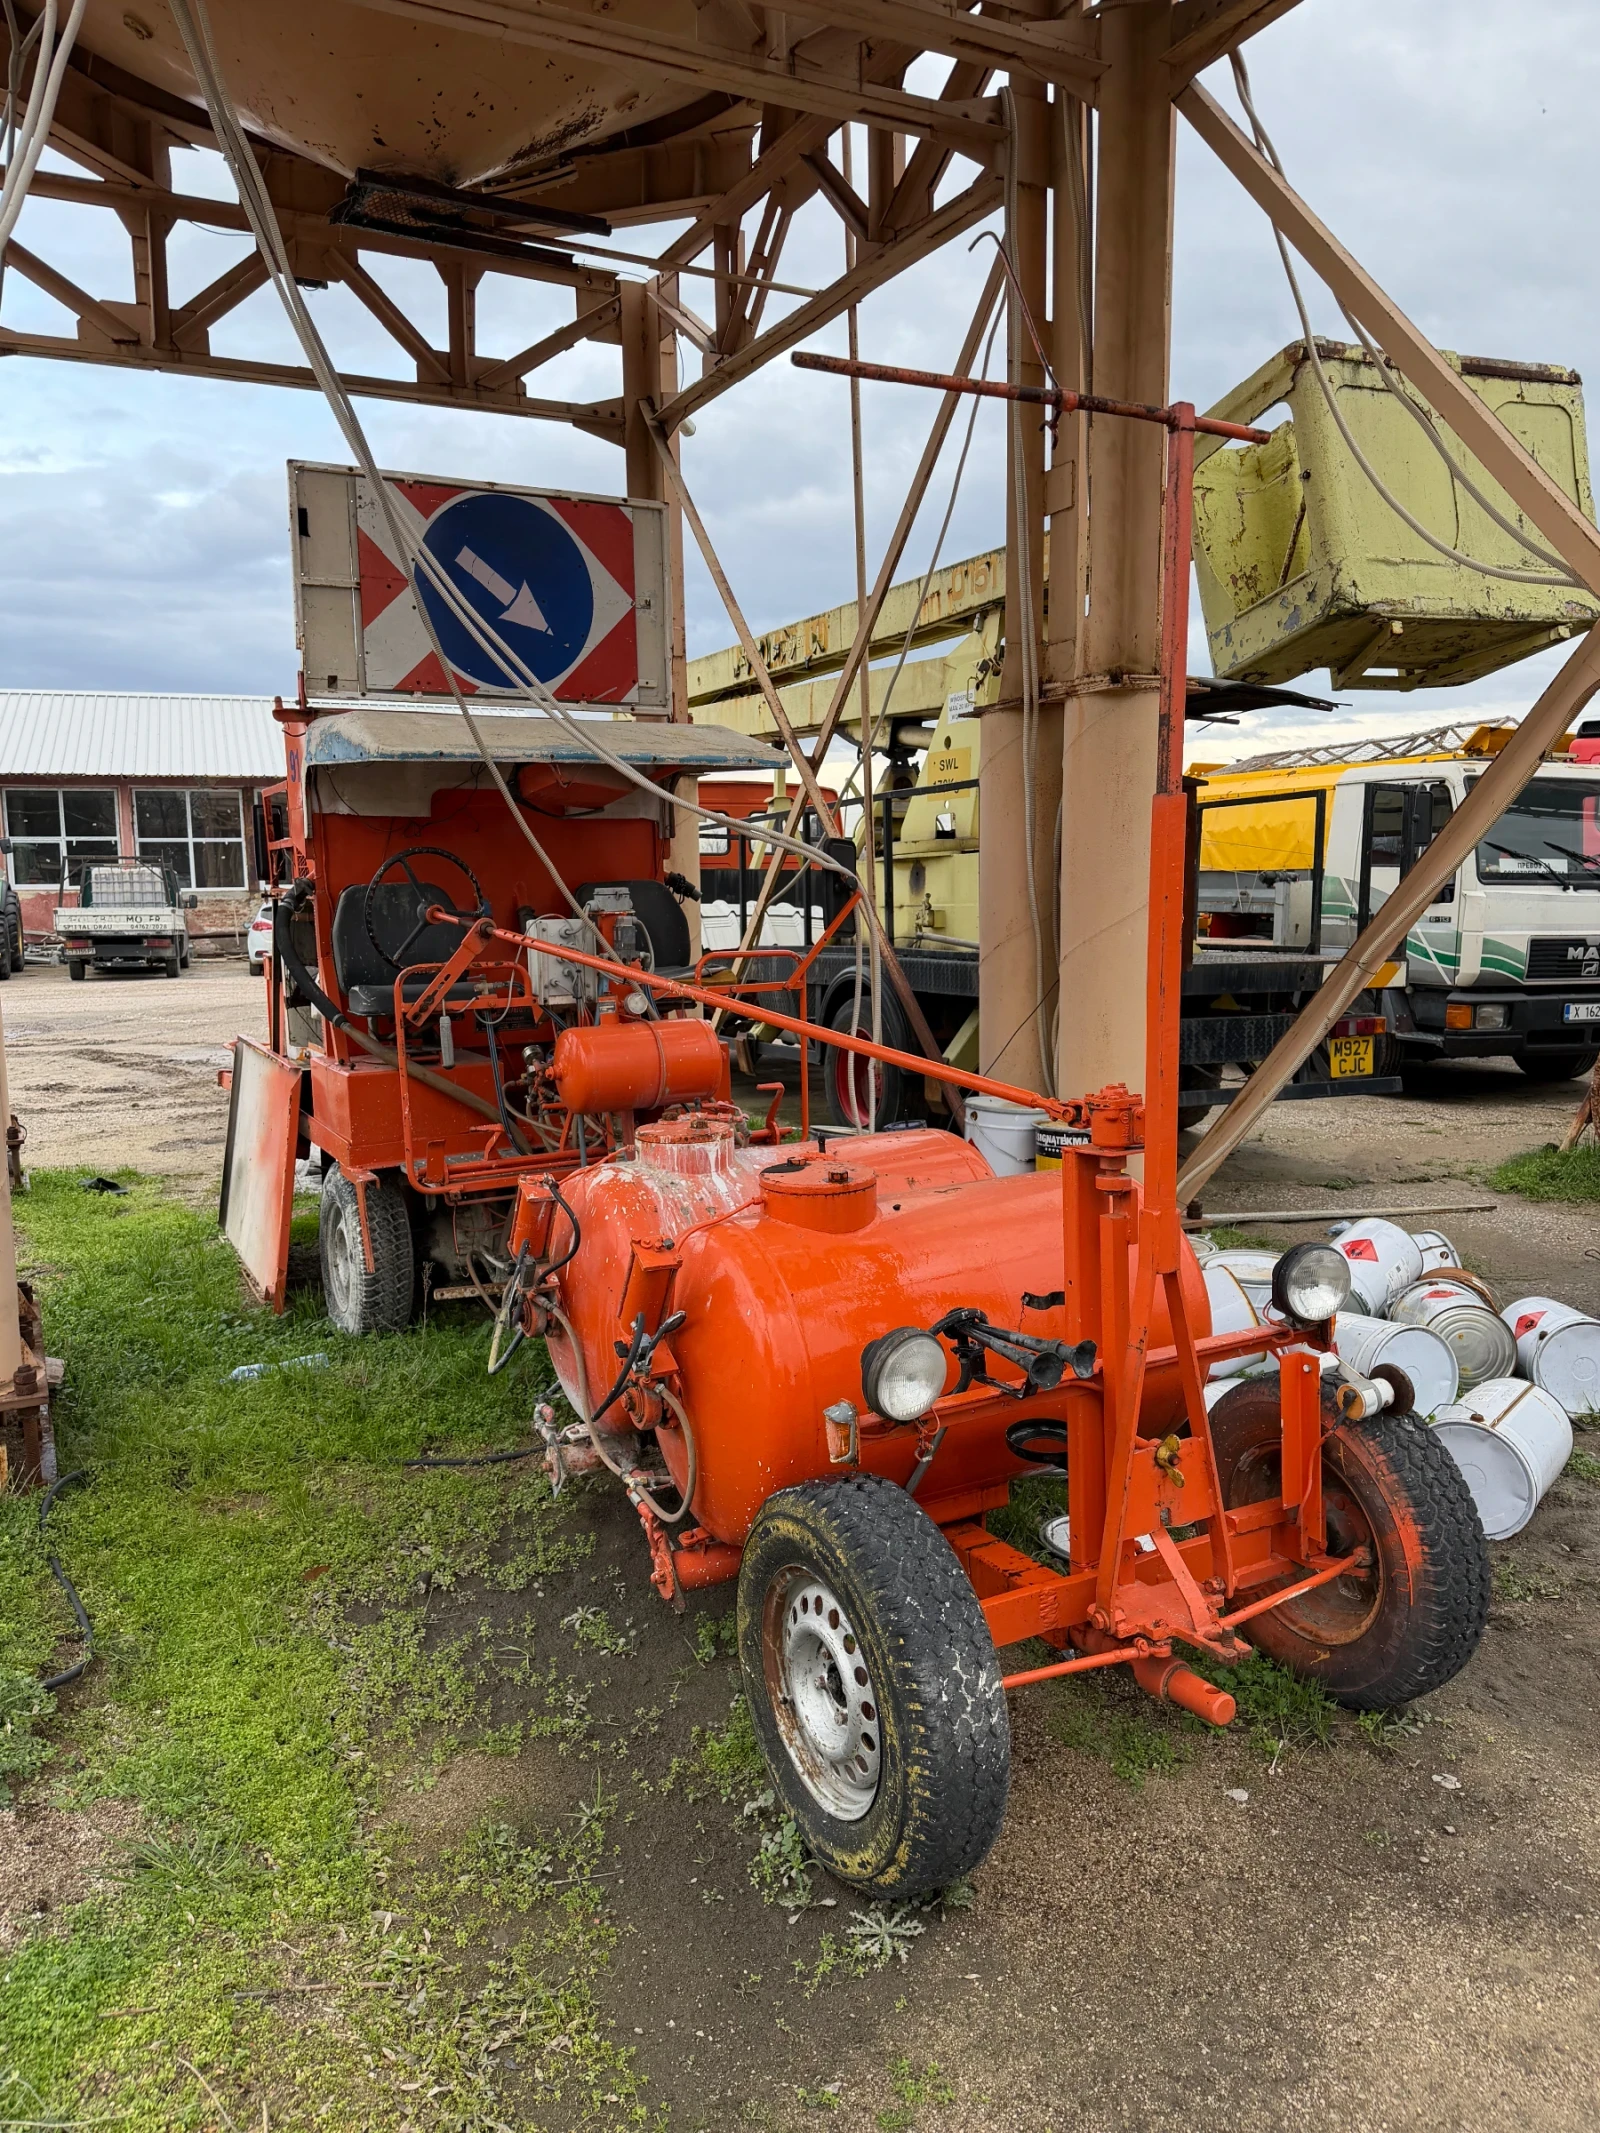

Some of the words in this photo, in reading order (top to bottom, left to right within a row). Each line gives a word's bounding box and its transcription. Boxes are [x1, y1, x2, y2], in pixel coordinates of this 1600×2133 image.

[290, 749, 300, 782] 91
[939, 758, 959, 771] SWL
[1334, 1039, 1370, 1057] M927
[1339, 1057, 1366, 1074] CJC
